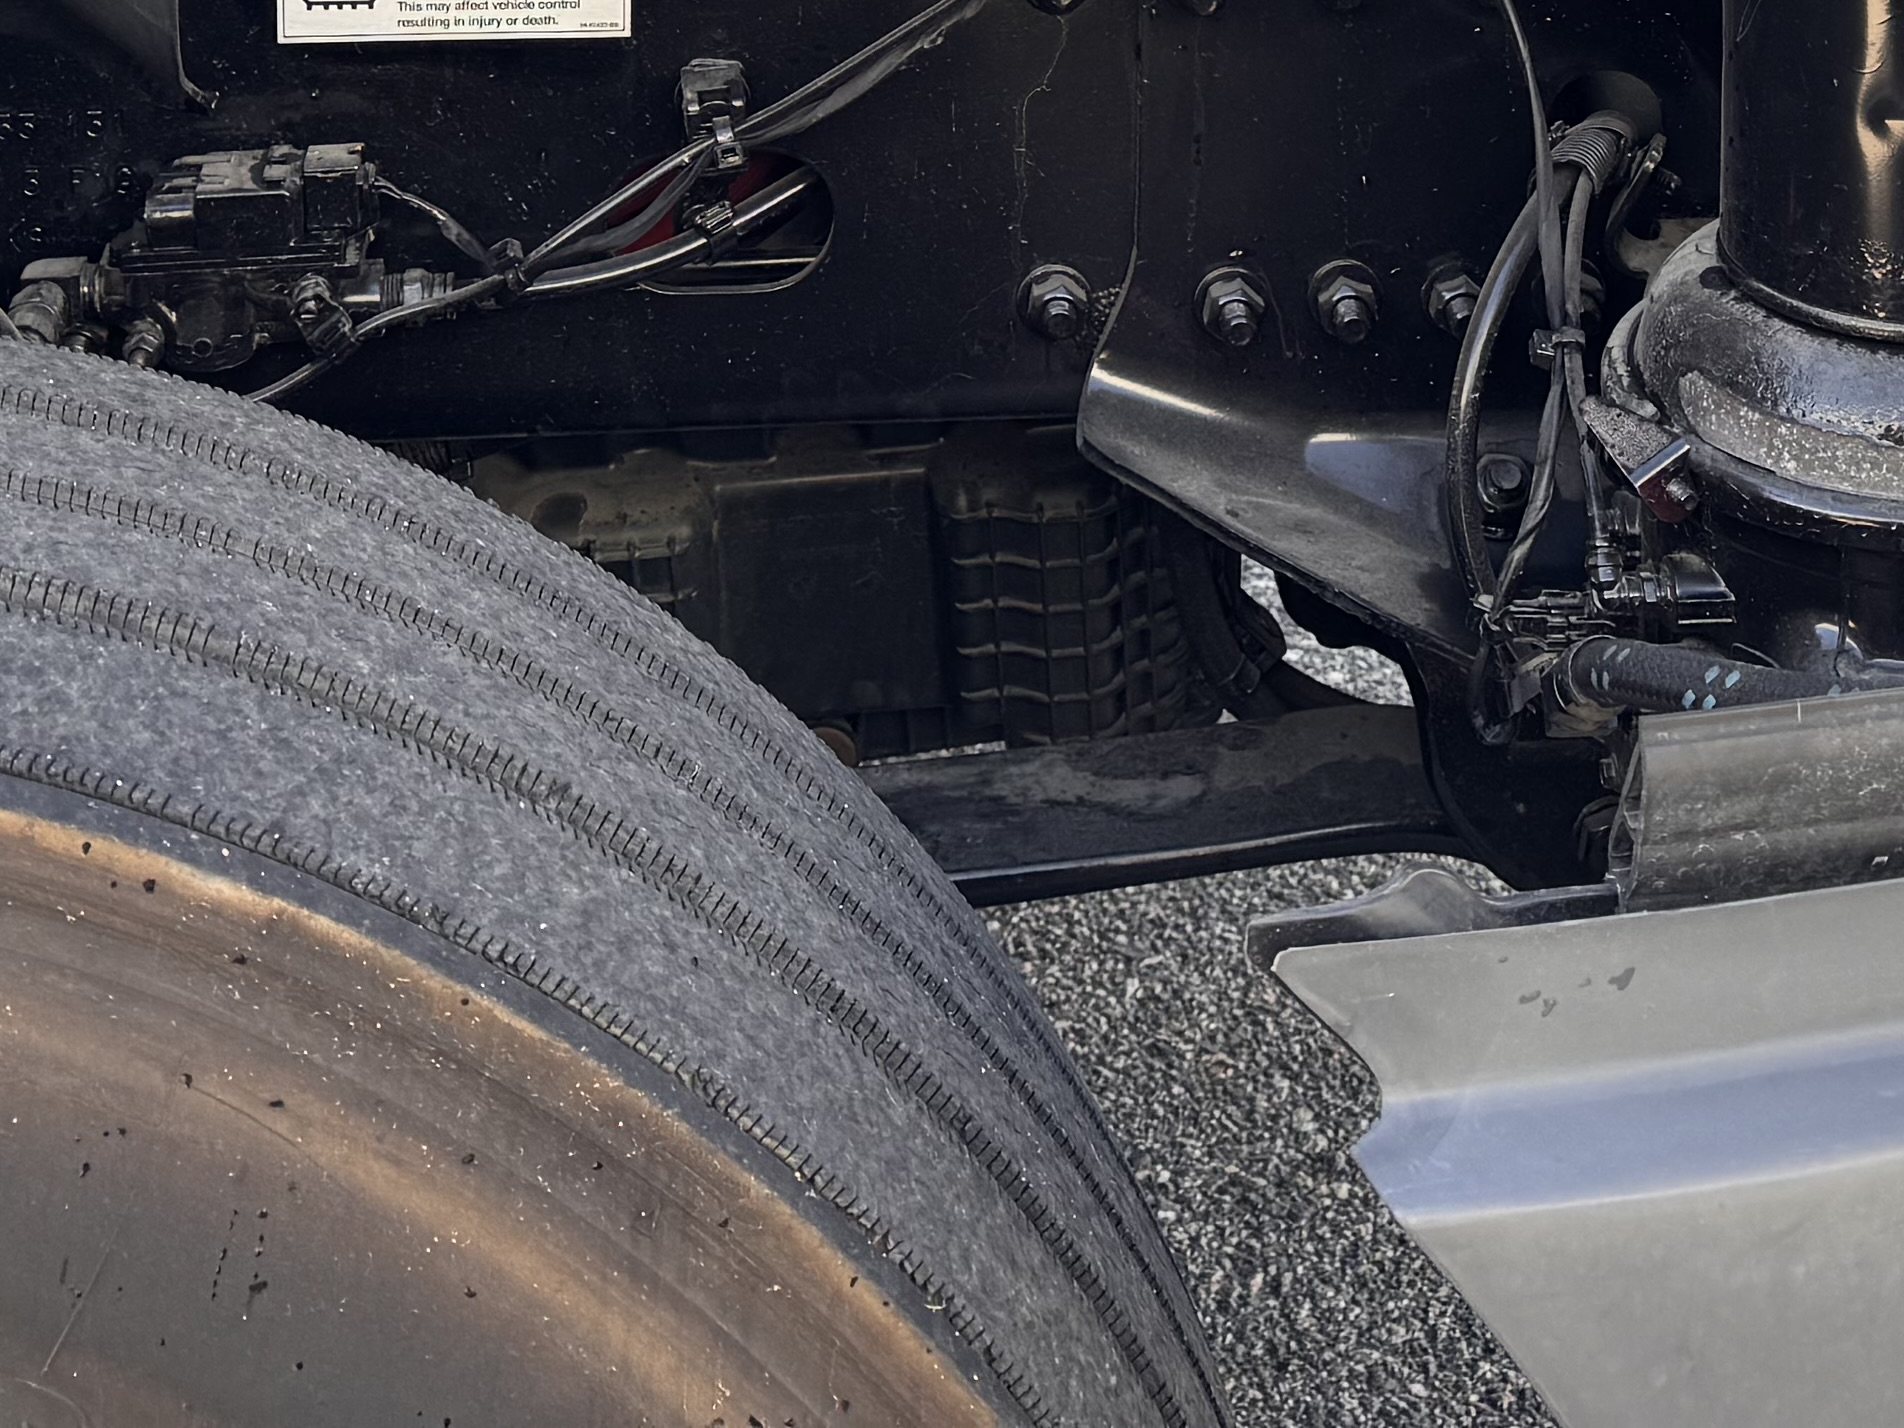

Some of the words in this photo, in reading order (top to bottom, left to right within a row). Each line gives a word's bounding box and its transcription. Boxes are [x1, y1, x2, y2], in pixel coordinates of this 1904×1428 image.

[397, 1, 423, 12] This
[425, 1, 451, 13] may
[454, 0, 490, 12] affect
[492, 0, 536, 11] vehicle
[397, 16, 451, 29] resulting
[453, 16, 466, 27] in
[467, 15, 503, 29] injury
[505, 16, 520, 27] or
[522, 14, 560, 26] death.
